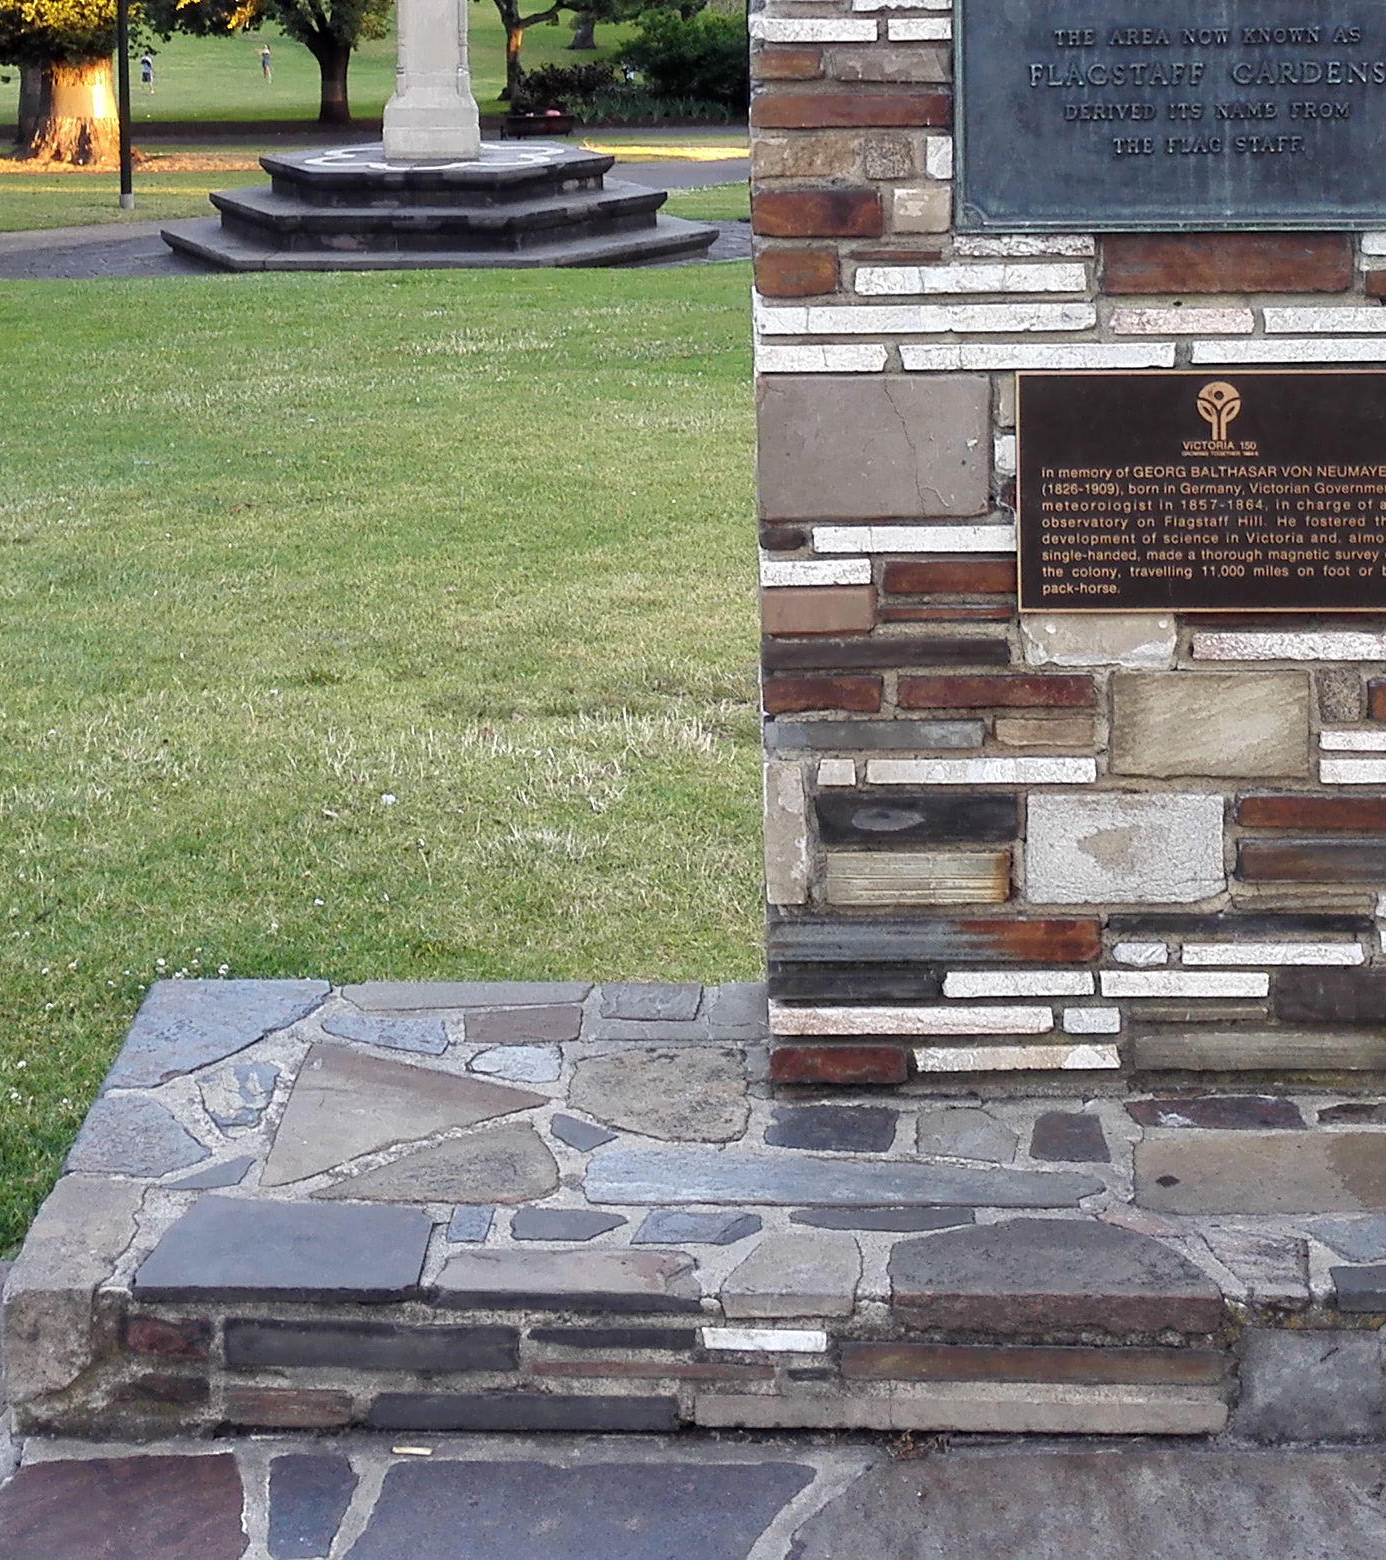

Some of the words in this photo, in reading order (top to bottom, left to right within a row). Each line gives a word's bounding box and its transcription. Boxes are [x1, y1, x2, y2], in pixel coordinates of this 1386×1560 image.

[1054, 29, 1094, 46] THE
[1109, 28, 1170, 45] AREA
[1182, 27, 1230, 44] NOW
[1243, 26, 1321, 44] KNOWN
[1333, 26, 1362, 43] AS
[1028, 62, 1205, 87] FLAGSTAFF
[1232, 61, 1386, 85] GARDENS
[1065, 102, 1157, 121] DERIVED
[1168, 102, 1202, 120] ITS
[1216, 102, 1276, 120] NAME
[1290, 102, 1351, 120] FROM
[1113, 137, 1154, 155] THE
[1168, 137, 1221, 154] FLAG
[1240, 441, 1257, 451] 150
[1059, 469, 1112, 480] memory
[1116, 466, 1129, 478] of
[1133, 466, 1186, 478] GEORG
[1191, 466, 1277, 477] BALTHASAR
[1281, 465, 1312, 477] VON
[1129, 483, 1159, 494] born
[1164, 483, 1175, 494] in
[1249, 483, 1310, 494] Victorian
[1042, 499, 1152, 513] meteorologist
[1160, 499, 1173, 510] in
[1276, 499, 1289, 510] in
[1297, 499, 1350, 513] charge
[1358, 499, 1372, 510] of
[1042, 517, 1128, 530] observatory
[1137, 518, 1154, 527] on
[1165, 515, 1229, 530] Flagstaff
[1277, 516, 1296, 527] He
[1306, 515, 1365, 527] fostered
[1042, 533, 1135, 546] development
[1142, 532, 1156, 544] of
[1163, 532, 1218, 544] science
[1226, 532, 1238, 543] in
[1246, 532, 1303, 543] Victoria
[1147, 549, 1182, 560] made
[1188, 551, 1195, 560] a
[1201, 549, 1262, 562] thorough
[1268, 548, 1329, 562] magnetic
[1335, 550, 1379, 562] survey
[1042, 565, 1063, 577] the
[1130, 565, 1192, 579] travelling
[1254, 565, 1289, 576] miles
[1298, 567, 1314, 576] on
[1323, 565, 1350, 576] foot
[1359, 567, 1373, 576] or
